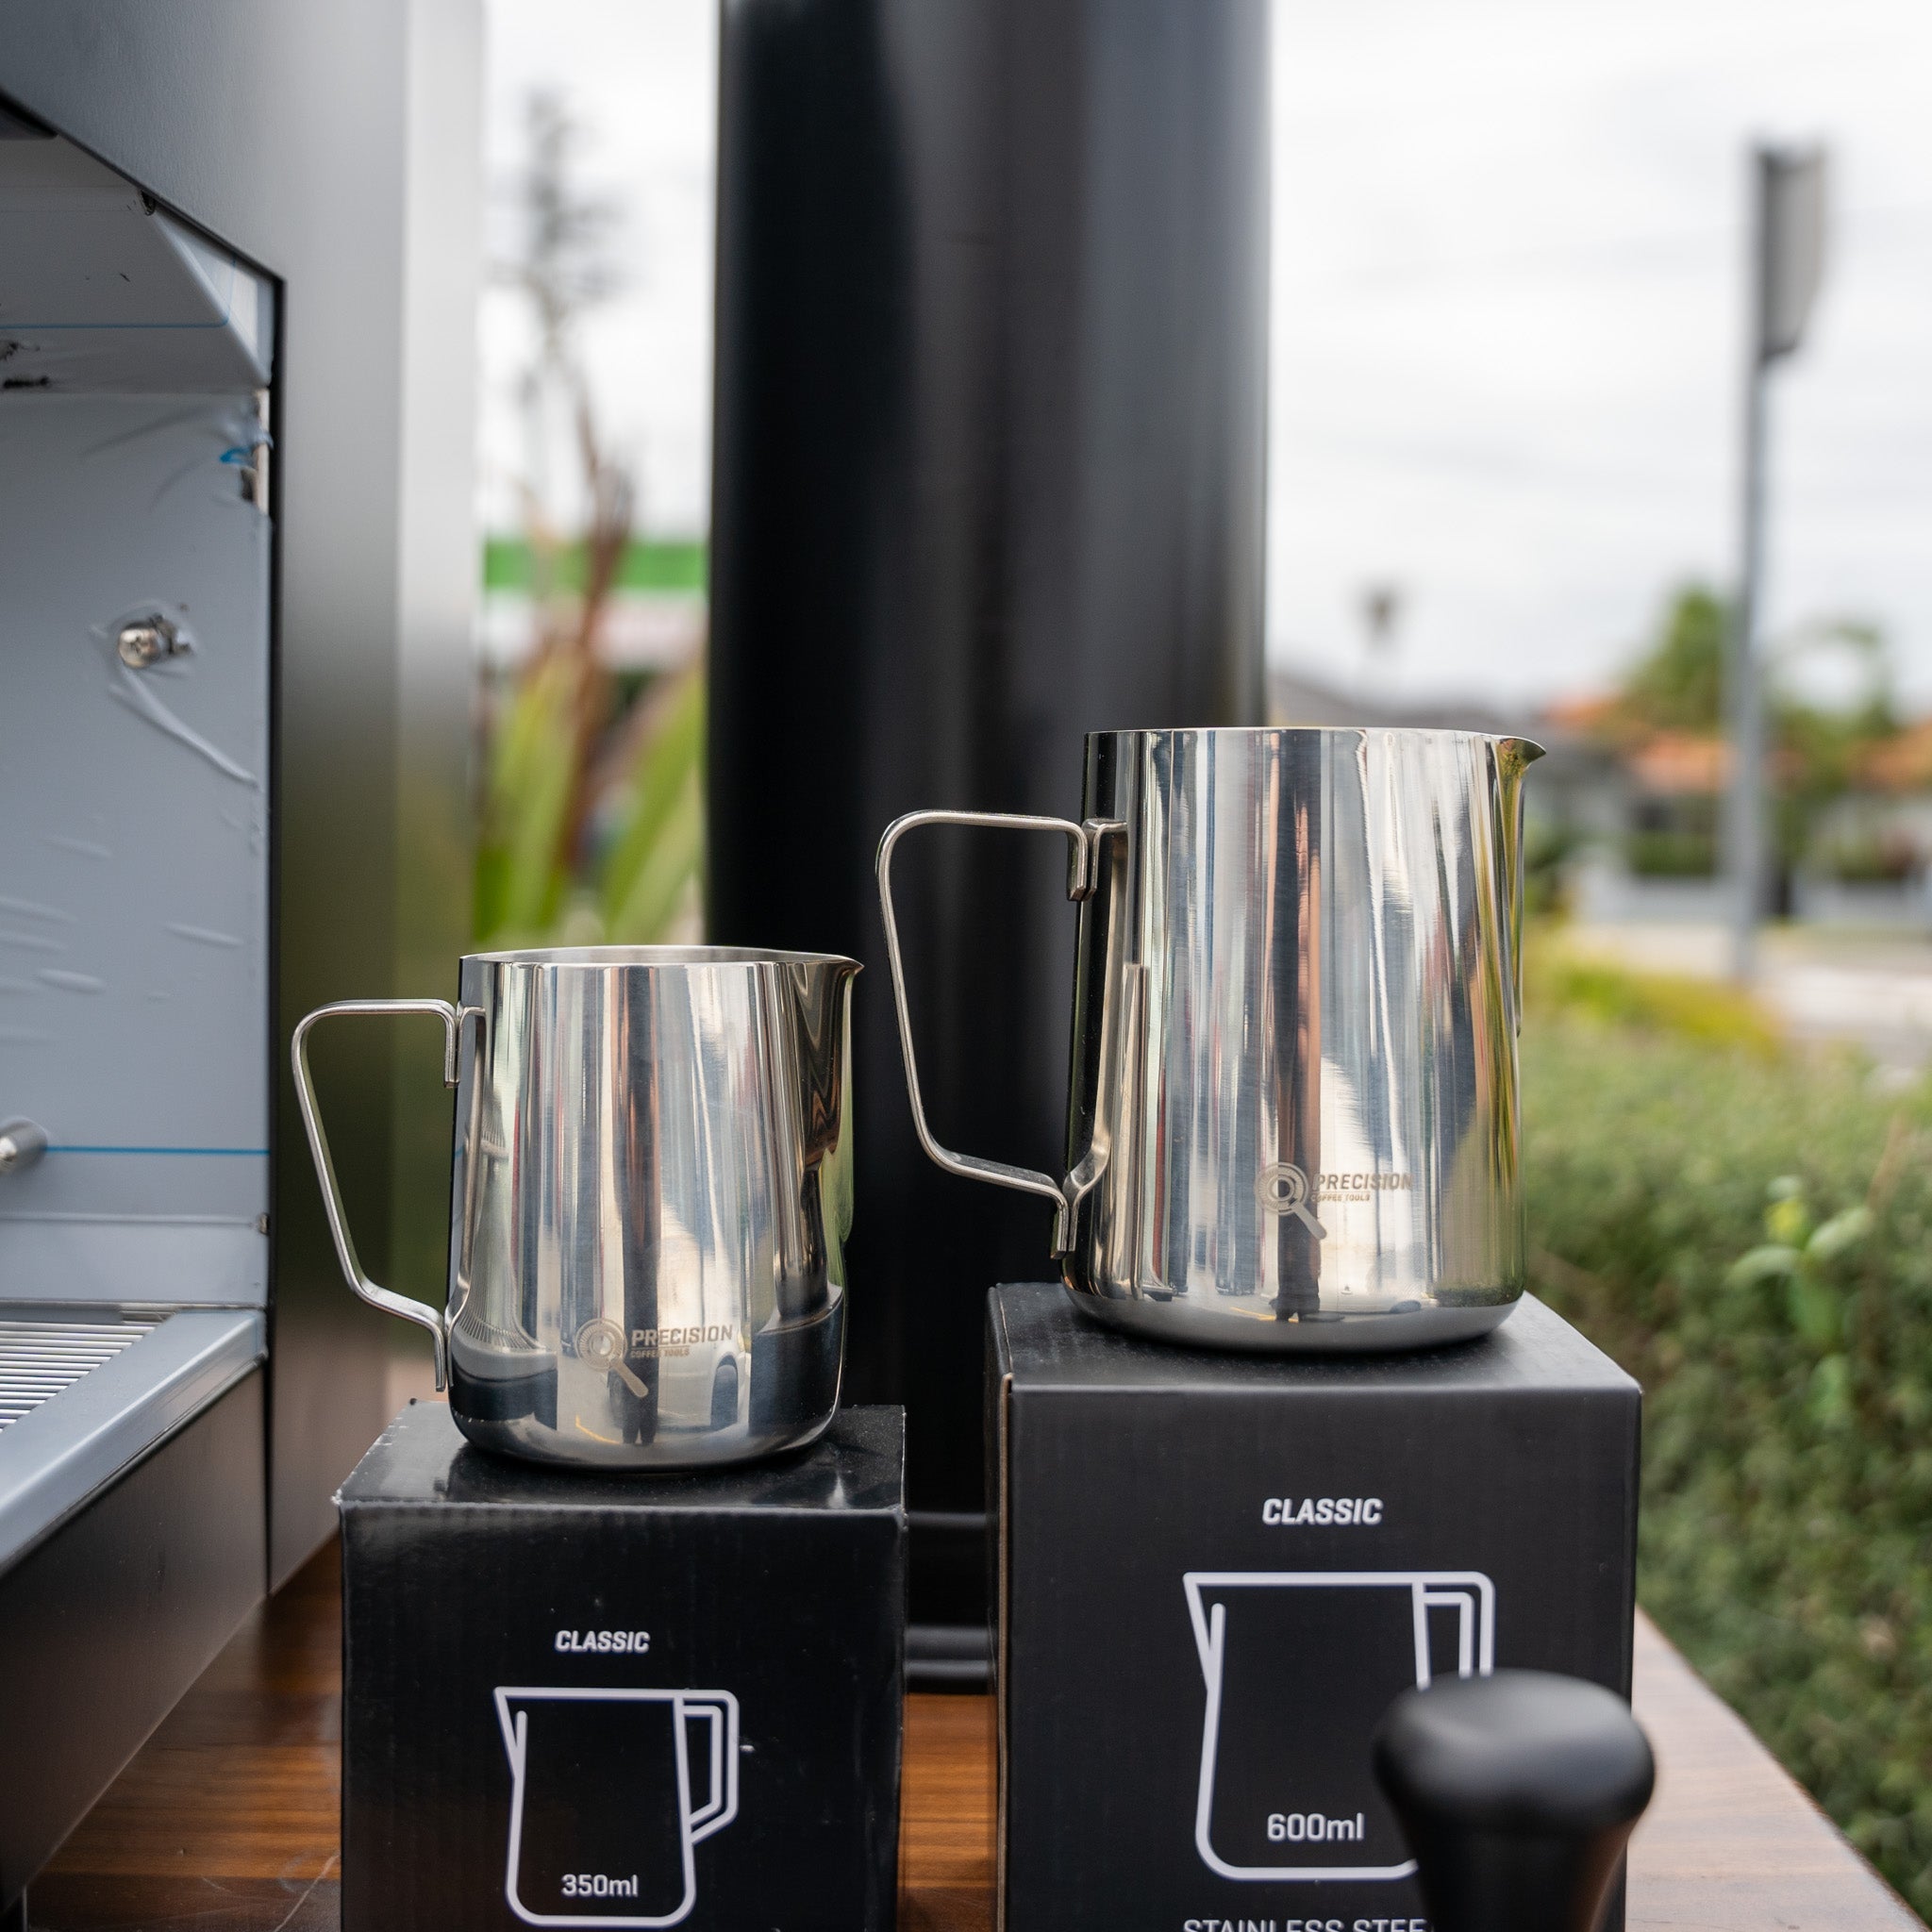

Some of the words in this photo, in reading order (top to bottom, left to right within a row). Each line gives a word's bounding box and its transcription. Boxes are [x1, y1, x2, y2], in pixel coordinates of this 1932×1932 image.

[1313, 1173, 1412, 1191] PRECISION
[631, 1324, 733, 1346] PRECISION
[1261, 1497, 1384, 1525] CLASSIC
[555, 1630, 650, 1654] CLASSIC
[1267, 1812, 1364, 1841] 600ml
[561, 1874, 638, 1897] 350ml
